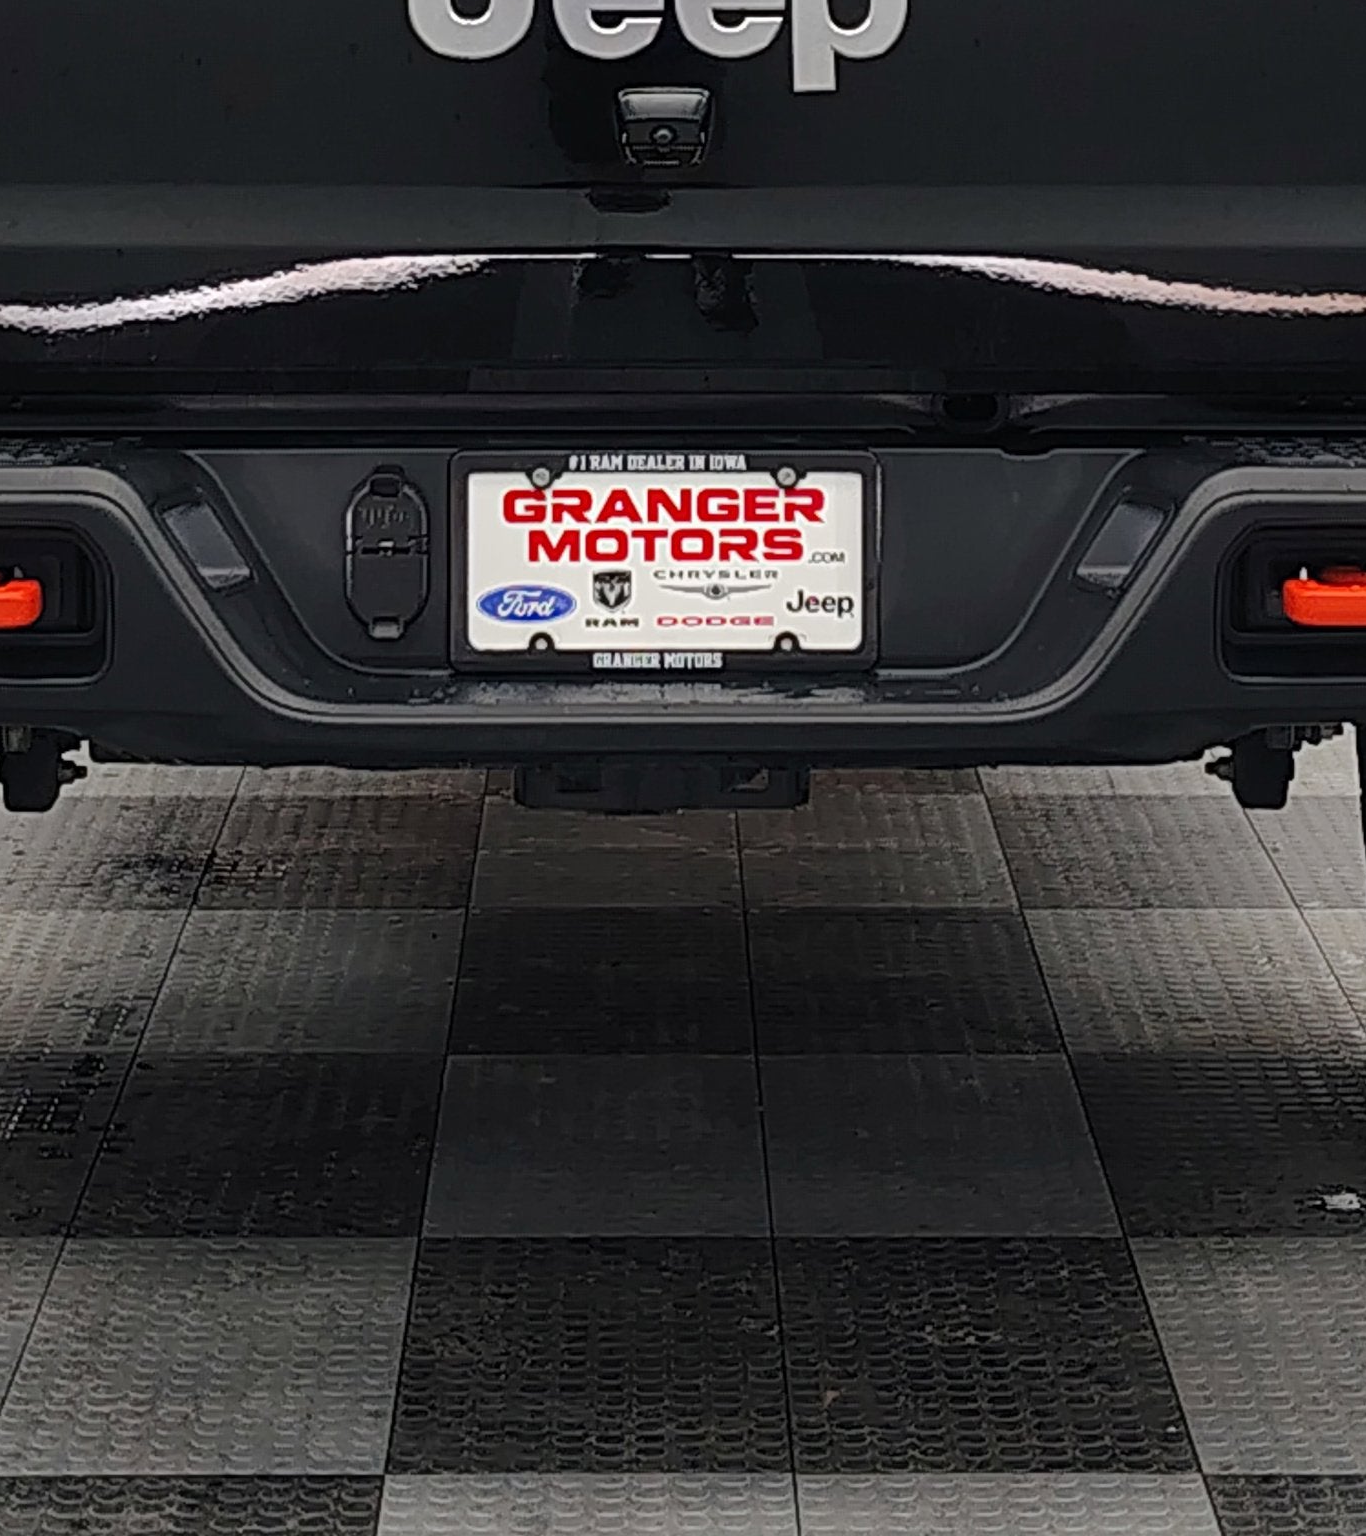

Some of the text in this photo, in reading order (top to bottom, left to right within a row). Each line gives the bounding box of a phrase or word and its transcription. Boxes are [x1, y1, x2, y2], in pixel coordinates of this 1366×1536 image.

[589, 454, 623, 471] RAM
[627, 454, 685, 471] DEALER
[688, 454, 706, 471] IN
[709, 454, 747, 471] IOWA
[502, 488, 825, 524] GRANGER
[528, 528, 804, 562] MOTORS
[653, 569, 779, 580] CHRYSLER
[496, 589, 555, 619] Ford
[786, 590, 854, 618] Jeep
[585, 618, 639, 628] RAM
[656, 616, 775, 627] DODGE
[592, 652, 723, 669] GRANGER MOTORS
